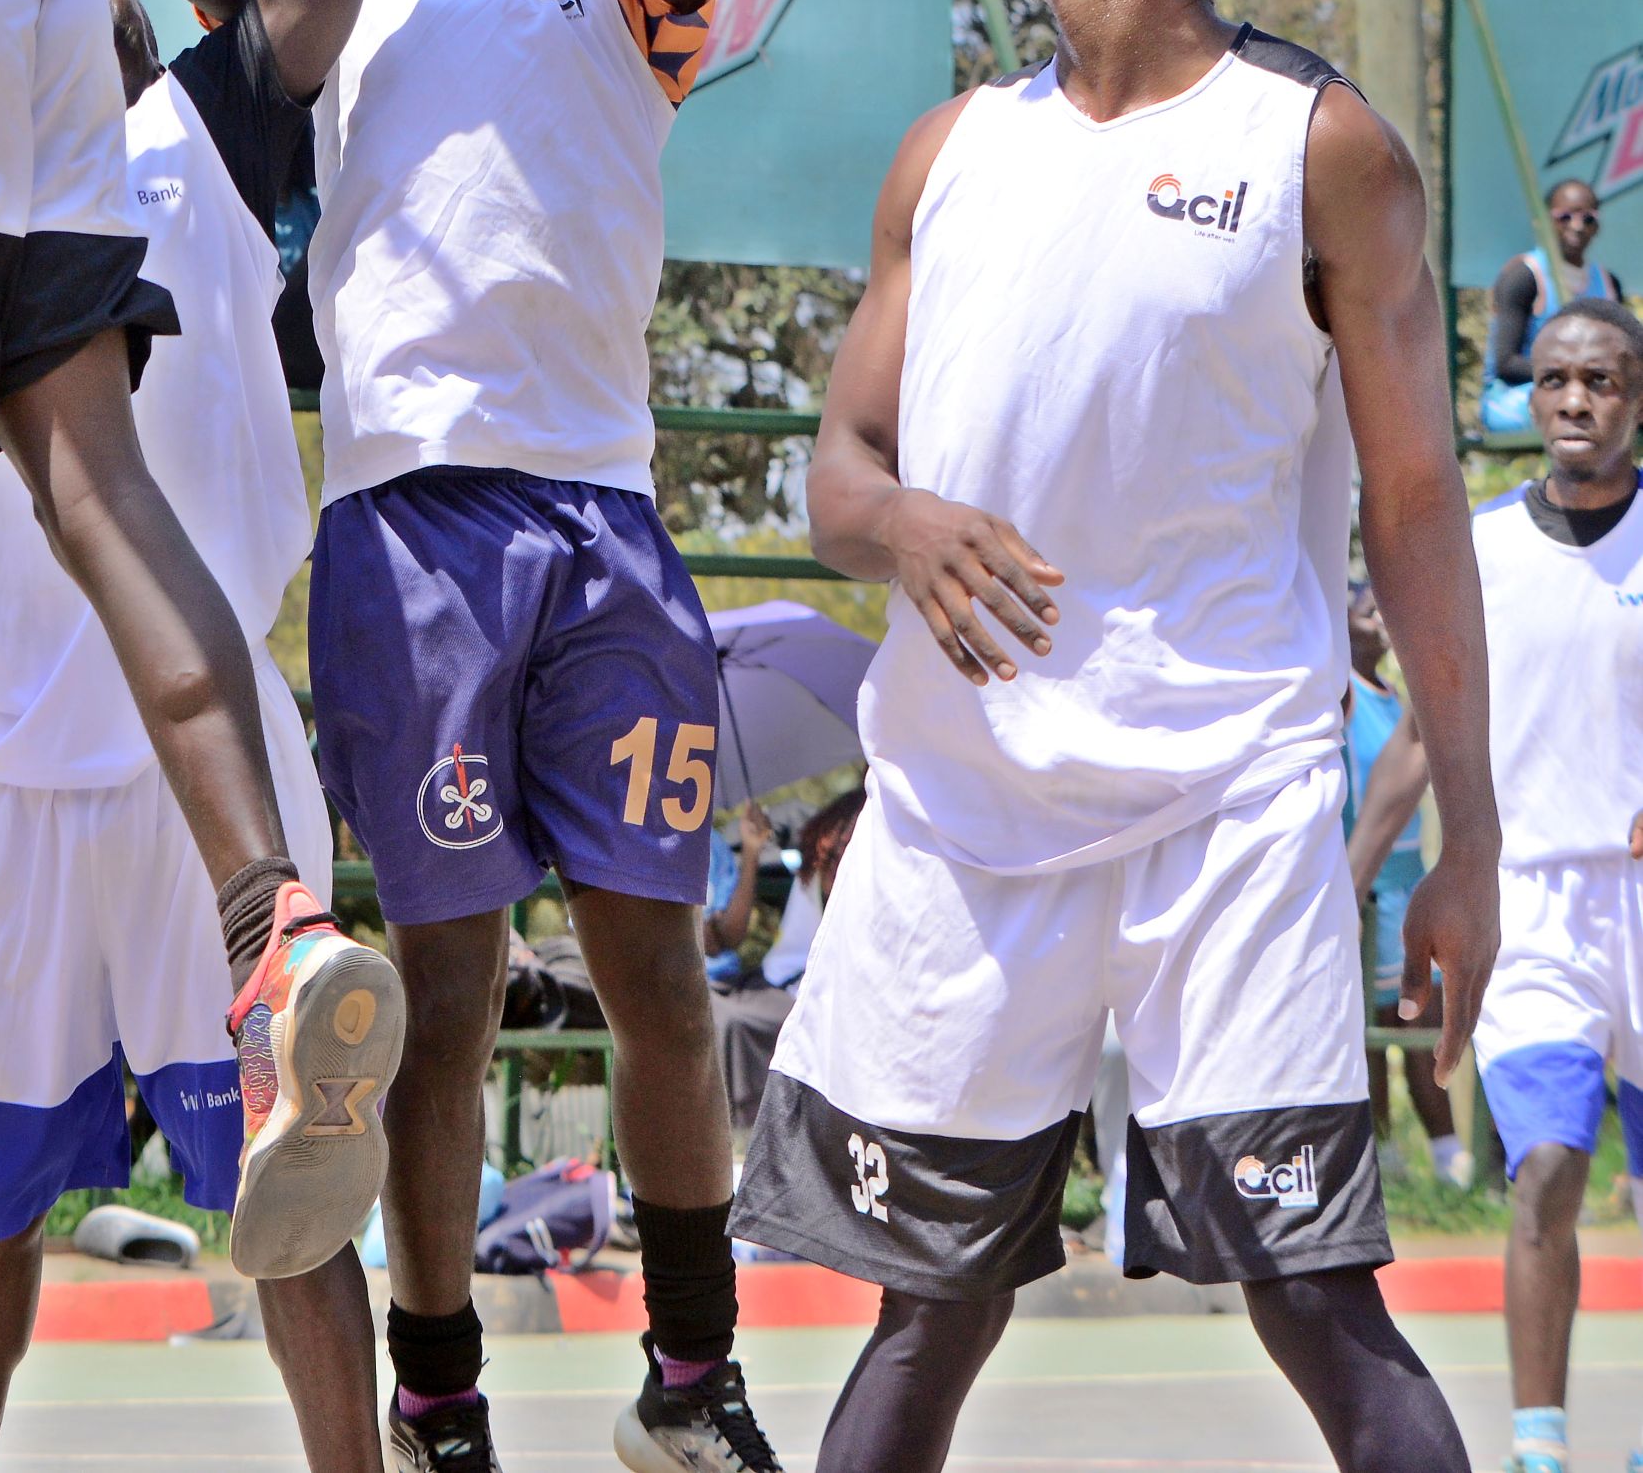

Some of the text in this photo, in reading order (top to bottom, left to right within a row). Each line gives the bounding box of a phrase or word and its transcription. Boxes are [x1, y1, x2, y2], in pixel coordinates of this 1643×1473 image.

[137, 182, 182, 205] Bank
[1146, 173, 1249, 233] Qcil
[610, 716, 715, 832] 15
[206, 1087, 241, 1109] Bank
[847, 1132, 890, 1223] 32
[1235, 1146, 1314, 1195] Qcil
